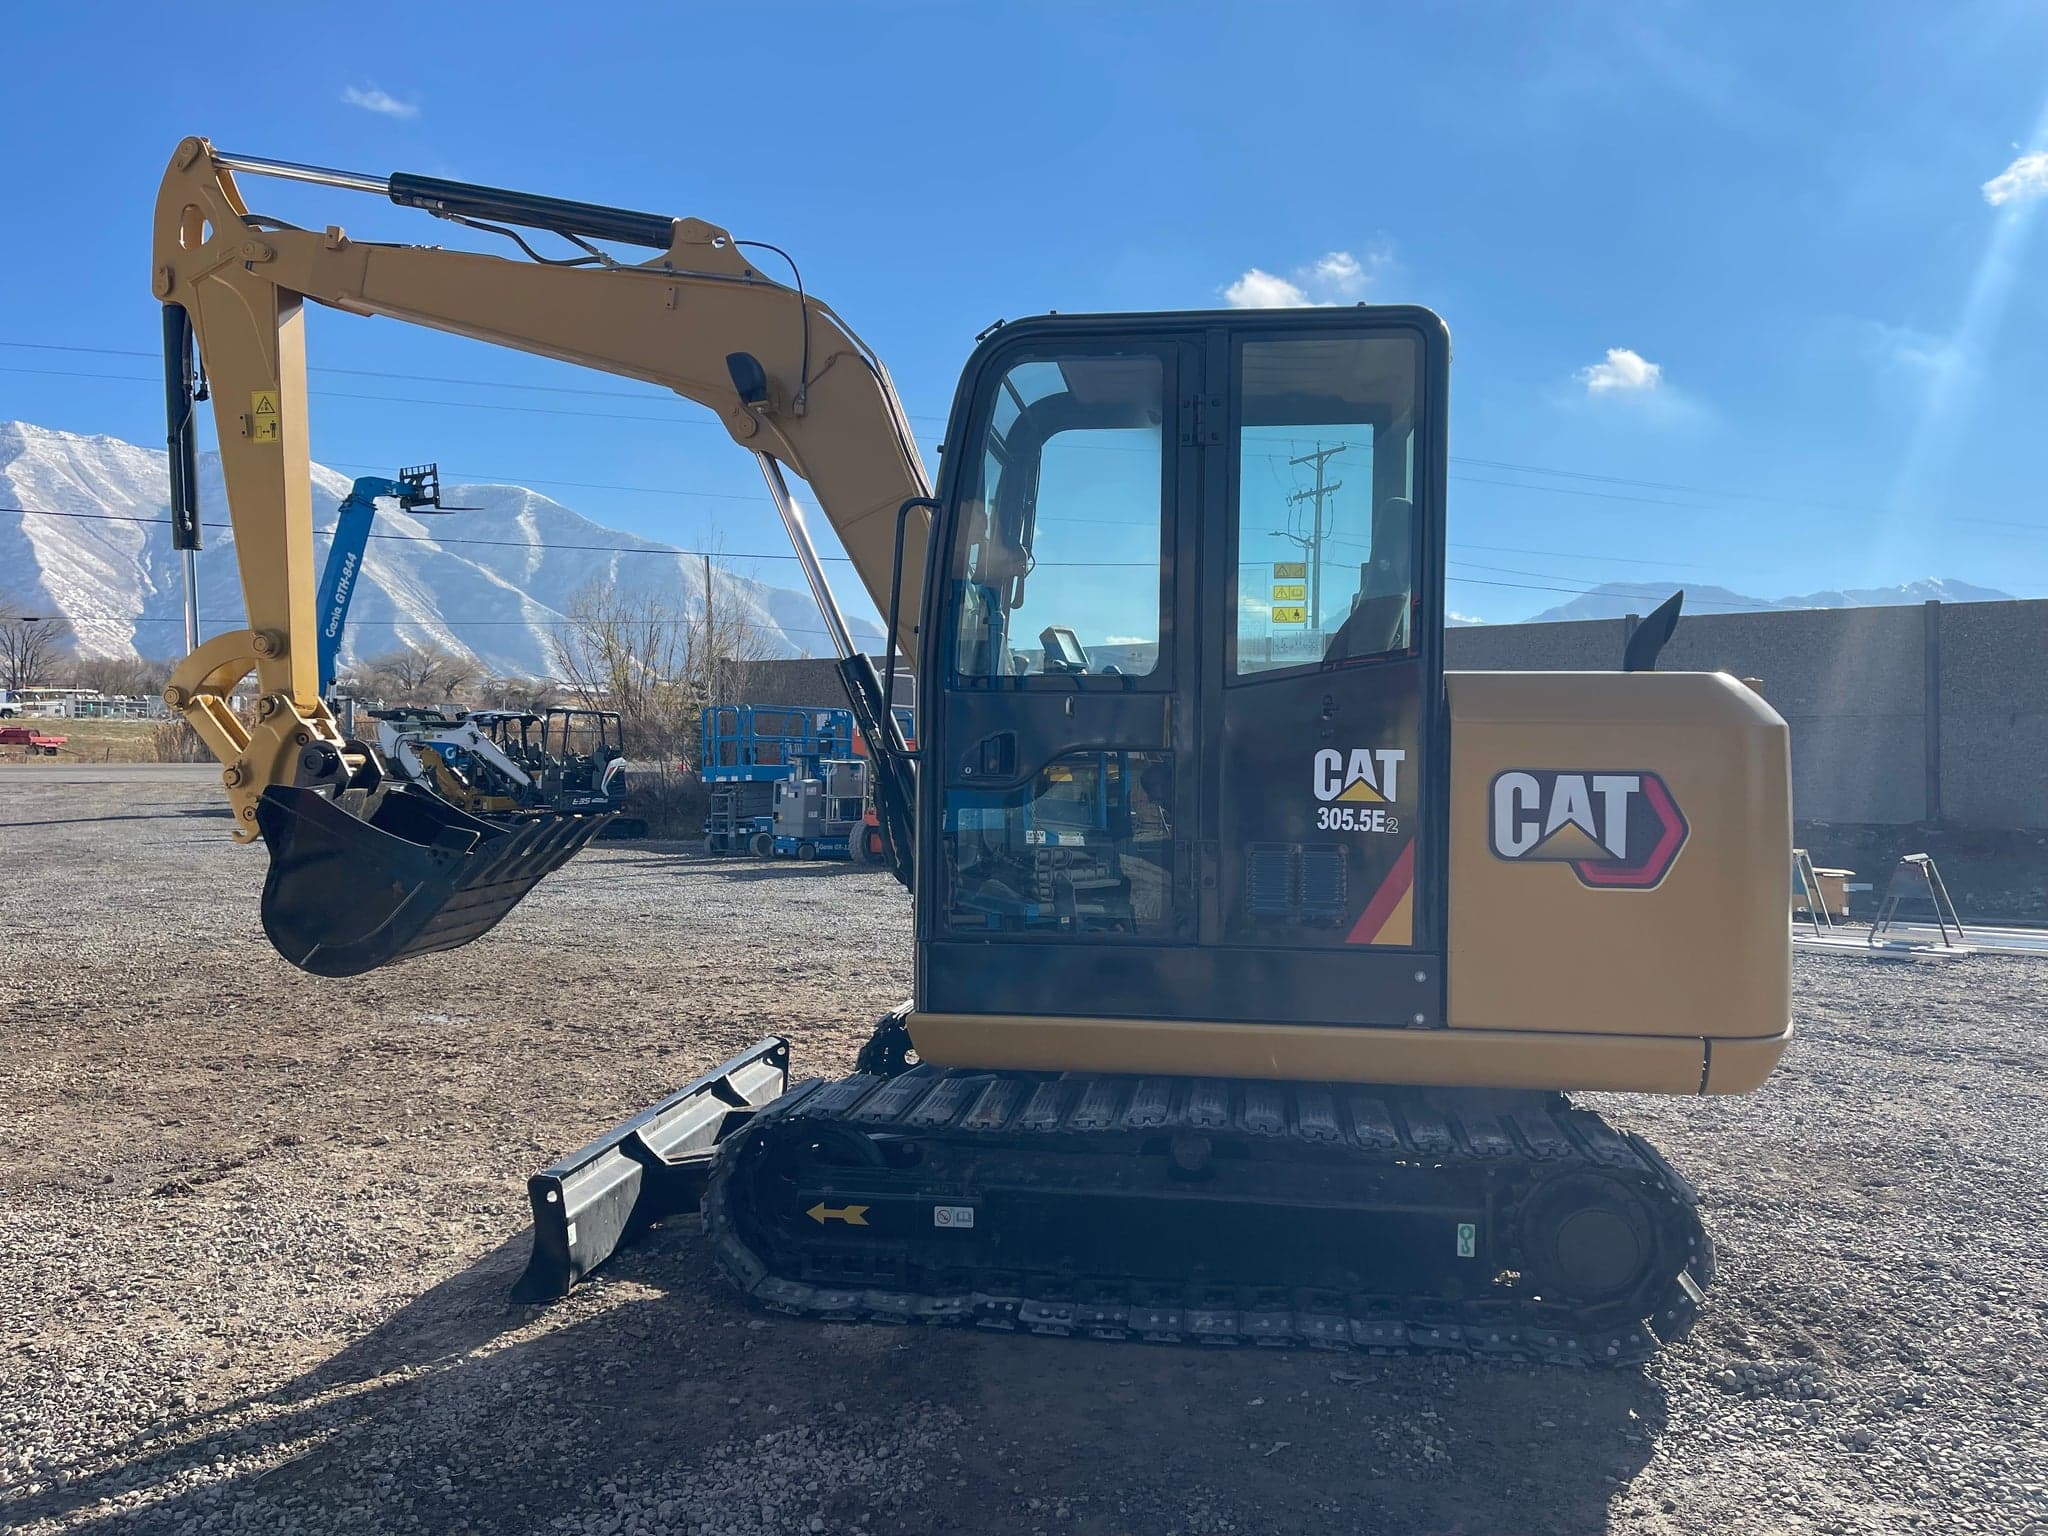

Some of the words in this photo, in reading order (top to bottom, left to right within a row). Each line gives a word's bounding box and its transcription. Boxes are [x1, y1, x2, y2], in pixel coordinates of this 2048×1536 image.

[325, 606, 343, 638] Genie
[335, 551, 358, 604] GTH-844
[1313, 748, 1406, 803] CAT
[1316, 806, 1400, 834] 305.5E2
[1494, 772, 1640, 859] CAT
